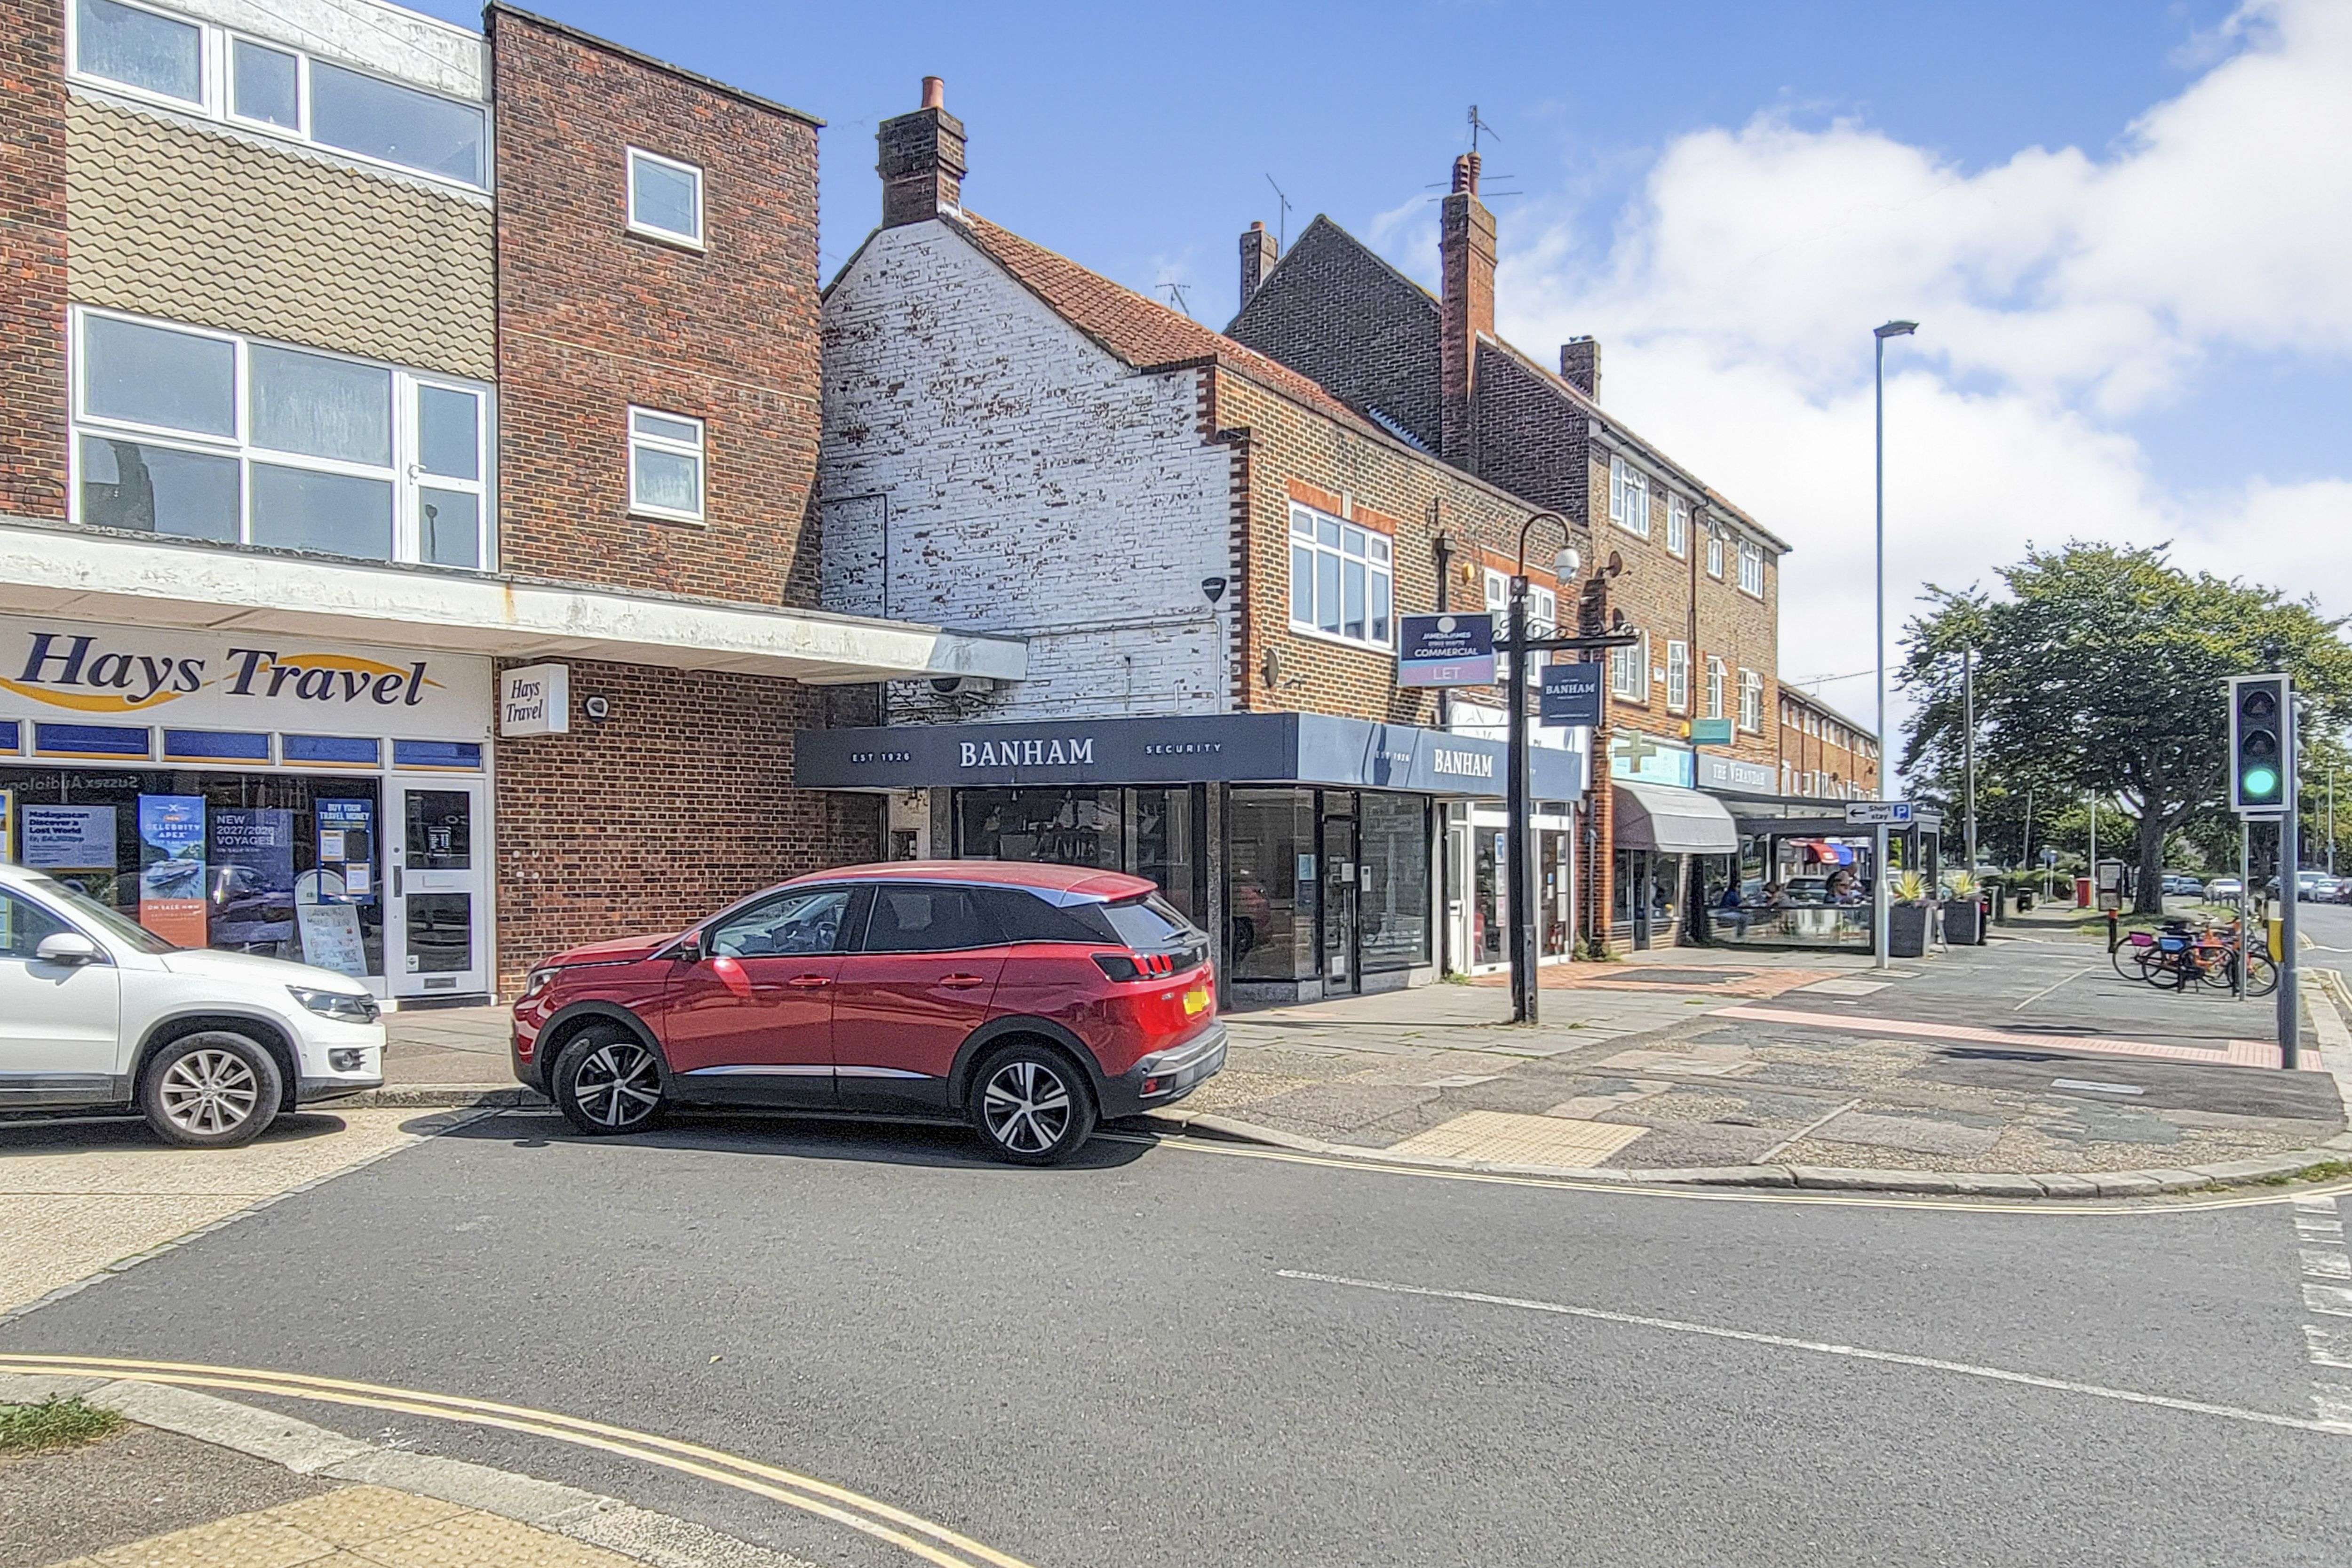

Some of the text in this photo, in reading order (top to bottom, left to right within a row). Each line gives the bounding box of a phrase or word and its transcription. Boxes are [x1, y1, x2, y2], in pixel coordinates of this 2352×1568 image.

[1414, 647, 1478, 657] COMMERCIAL
[15, 632, 428, 706] Hays Travel
[1433, 666, 1461, 679] LET
[511, 679, 540, 702] Hays
[1545, 682, 1595, 694] BANHAM
[506, 699, 543, 723] Travel
[959, 738, 1094, 767] BANHAM
[1146, 743, 1222, 754] SECURITY
[852, 753, 910, 762] EST 1926
[1393, 752, 1410, 762] 1926
[1433, 748, 1493, 778] BANHAM
[1713, 764, 1727, 780] THE
[1898, 806, 1907, 819] P
[216, 815, 245, 825] NEW
[216, 836, 275, 846] VOYAGES
